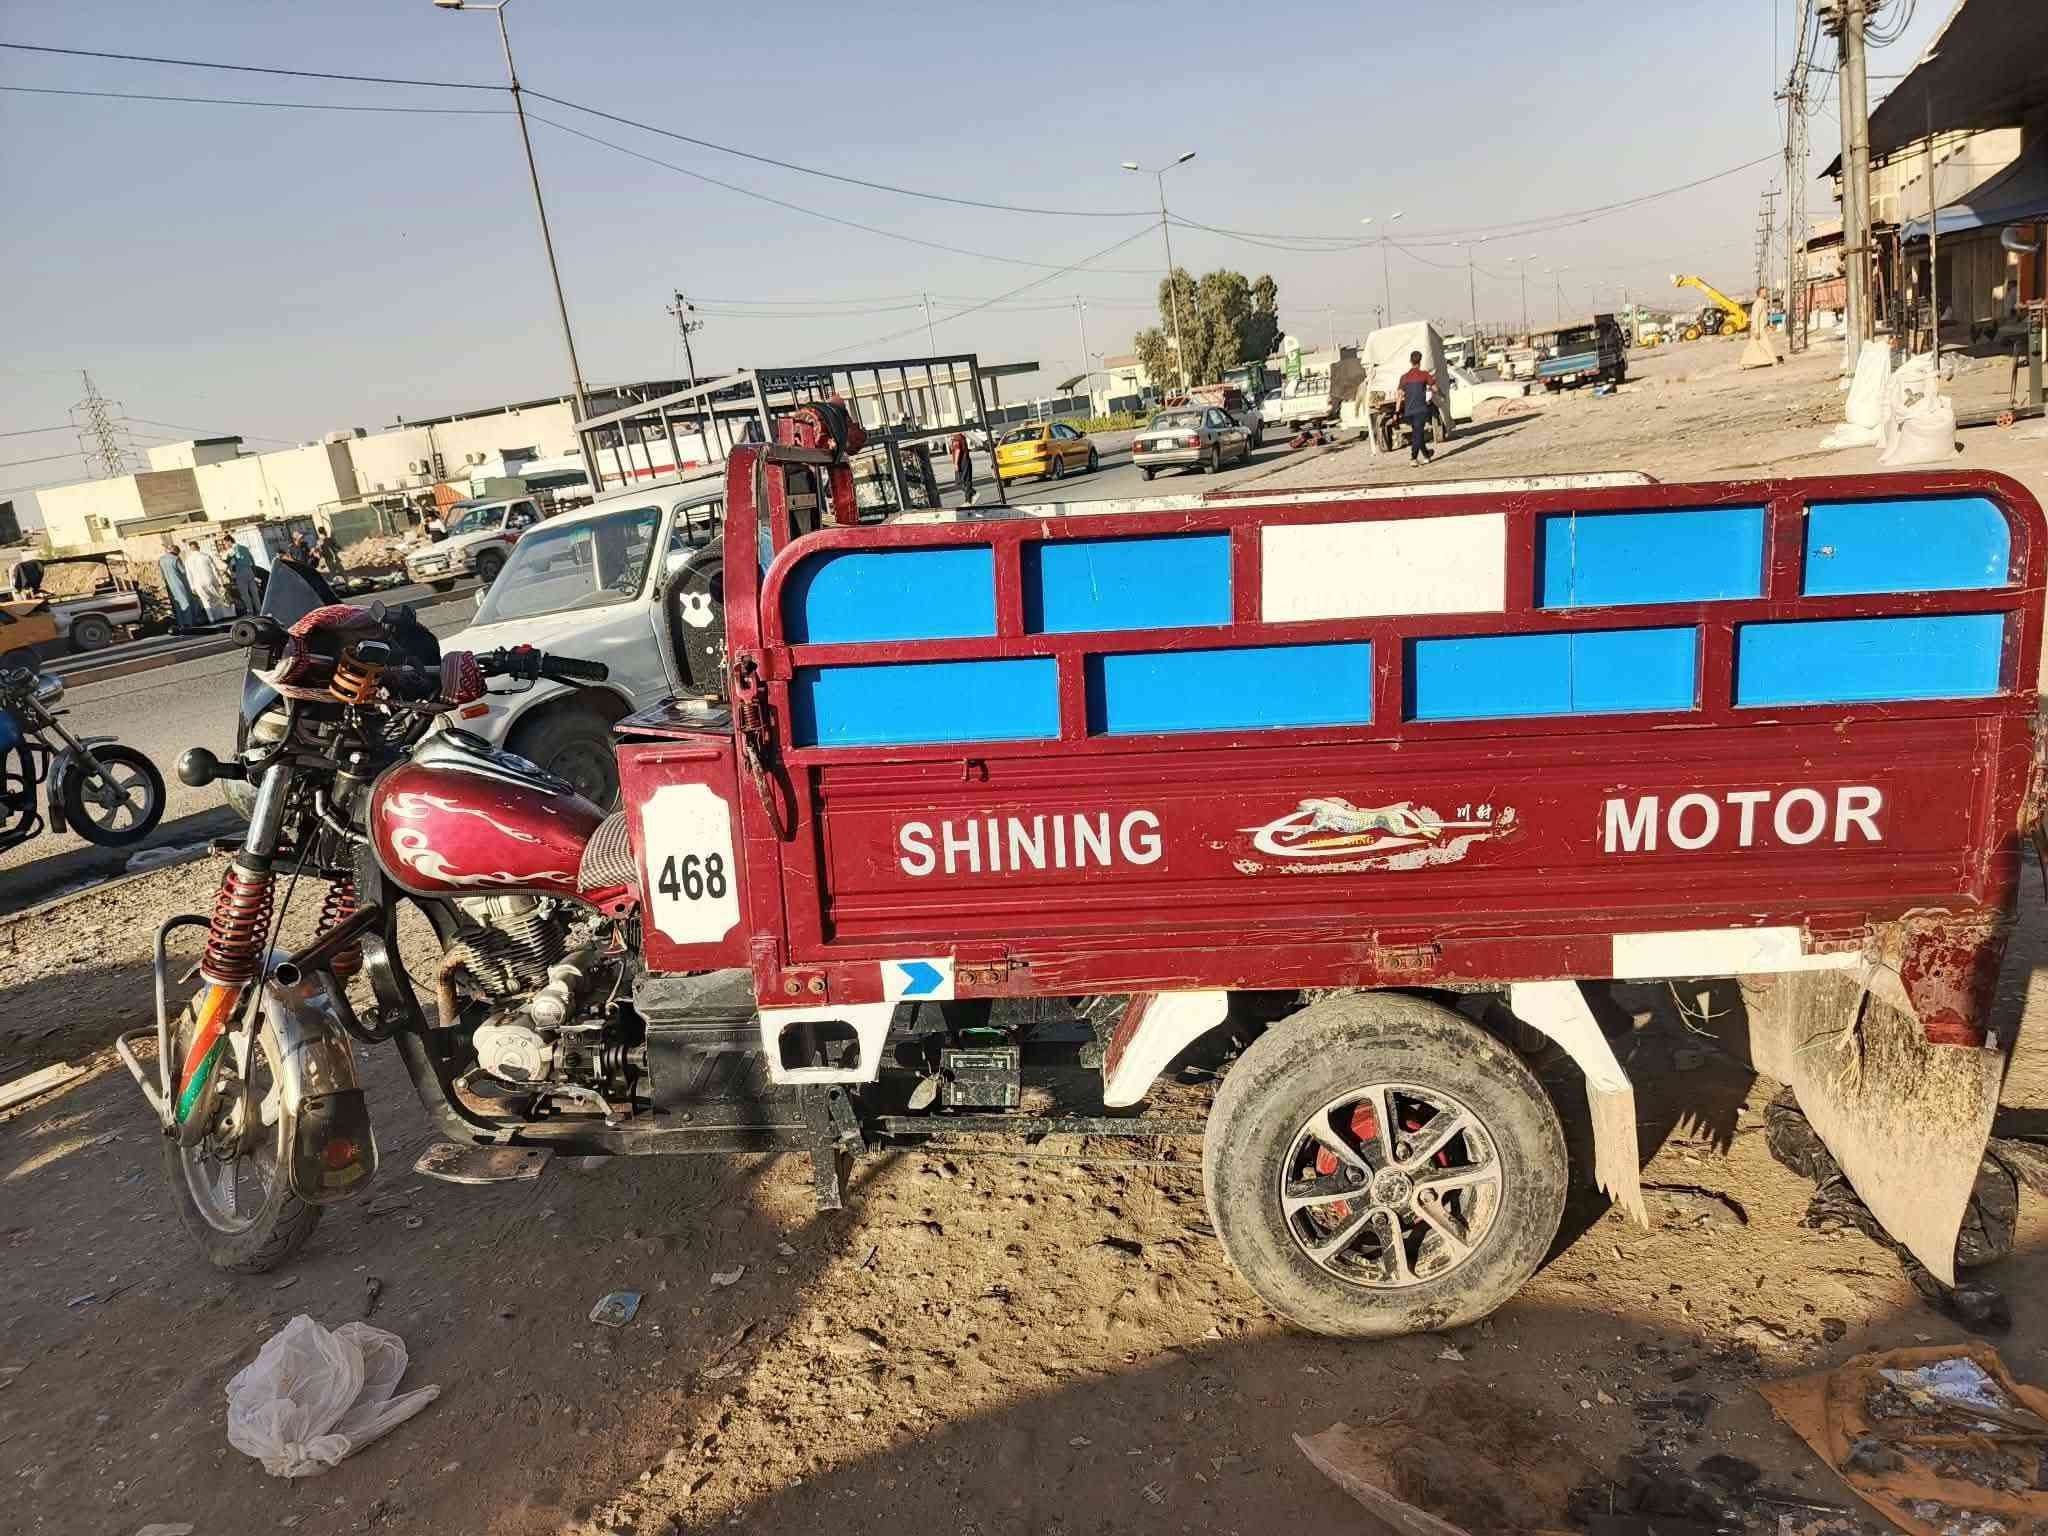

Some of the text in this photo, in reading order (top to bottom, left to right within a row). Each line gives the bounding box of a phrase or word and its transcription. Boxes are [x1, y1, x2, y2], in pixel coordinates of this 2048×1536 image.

[899, 810, 1163, 877] SHINING
[1603, 786, 1884, 854] MOTOR
[658, 852, 727, 902] 468
